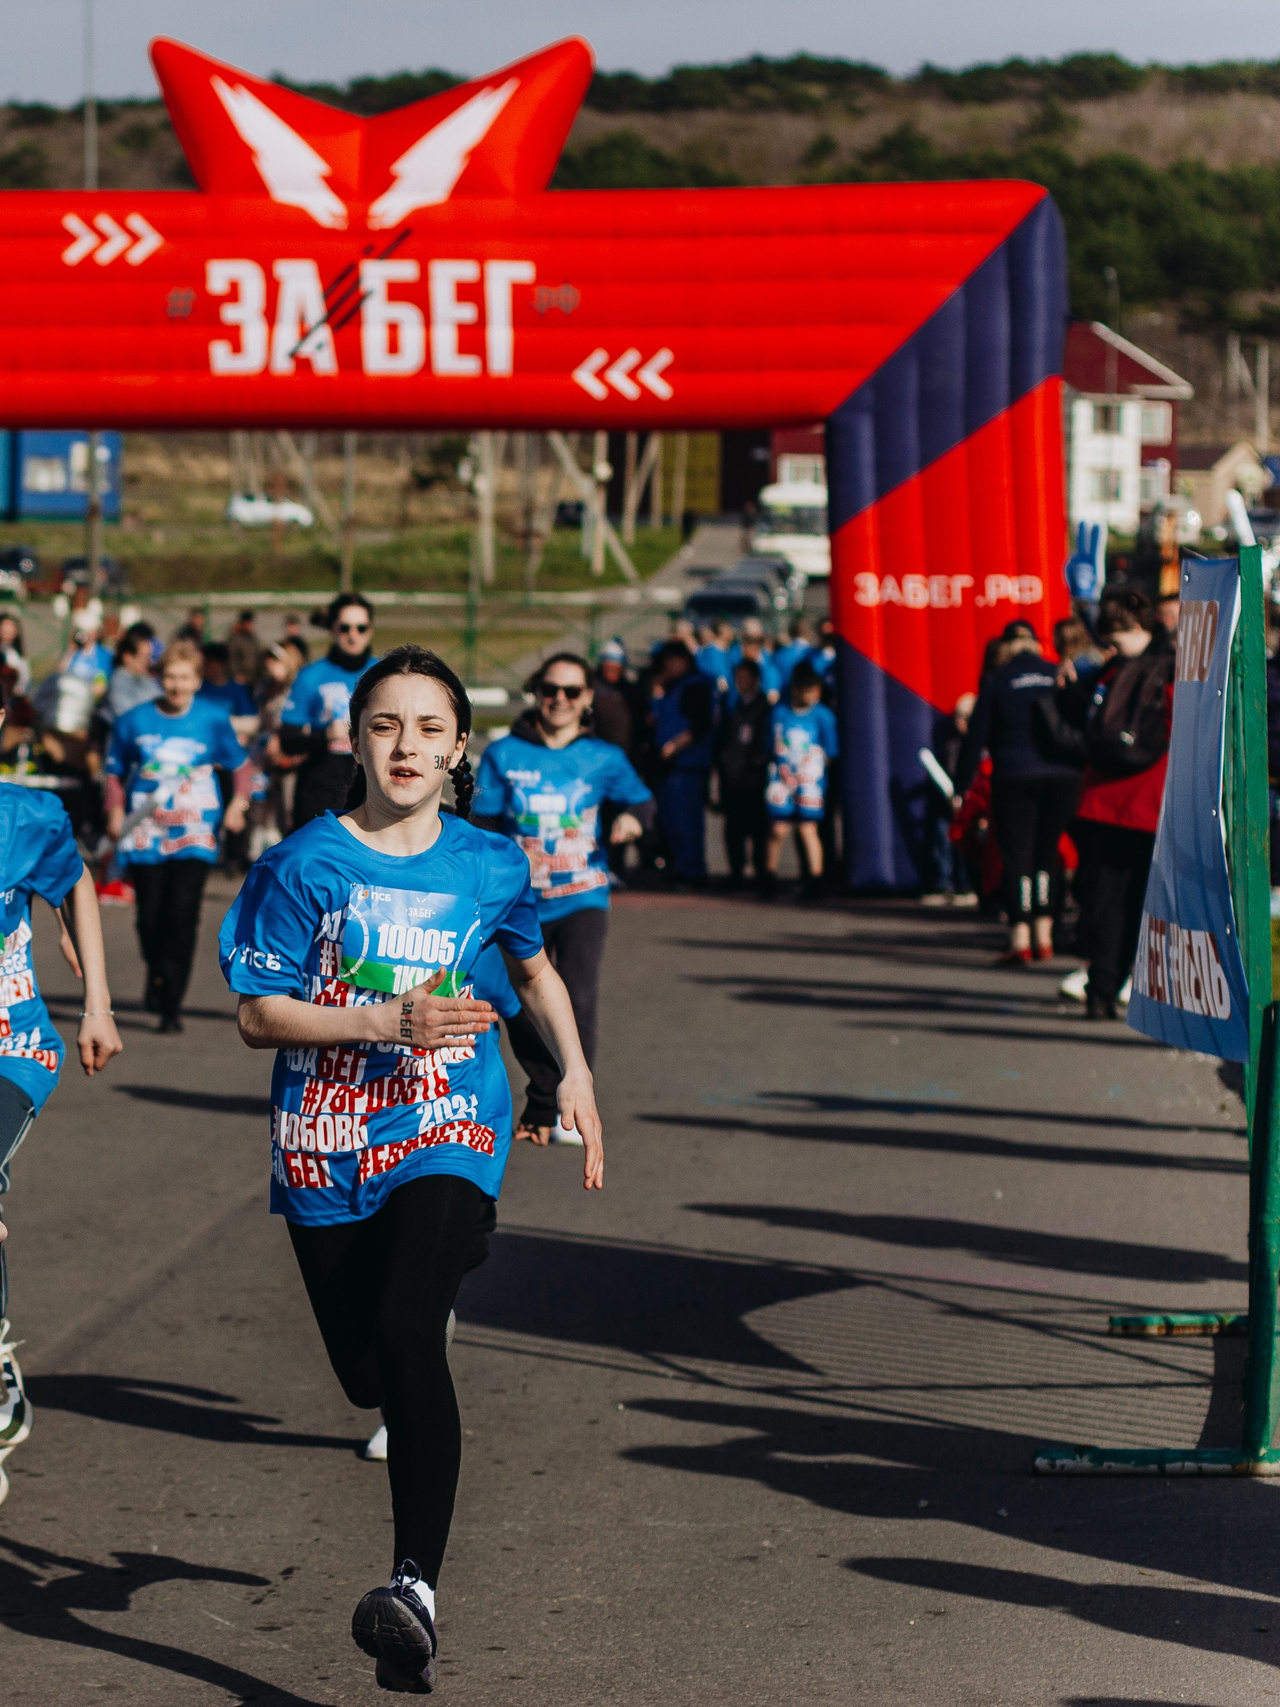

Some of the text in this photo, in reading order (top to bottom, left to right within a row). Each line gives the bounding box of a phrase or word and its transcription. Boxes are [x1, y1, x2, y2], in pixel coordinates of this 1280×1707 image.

[371, 891, 392, 902] ПСБ
[376, 923, 458, 966] 10005
[239, 946, 282, 971] ПСБ
